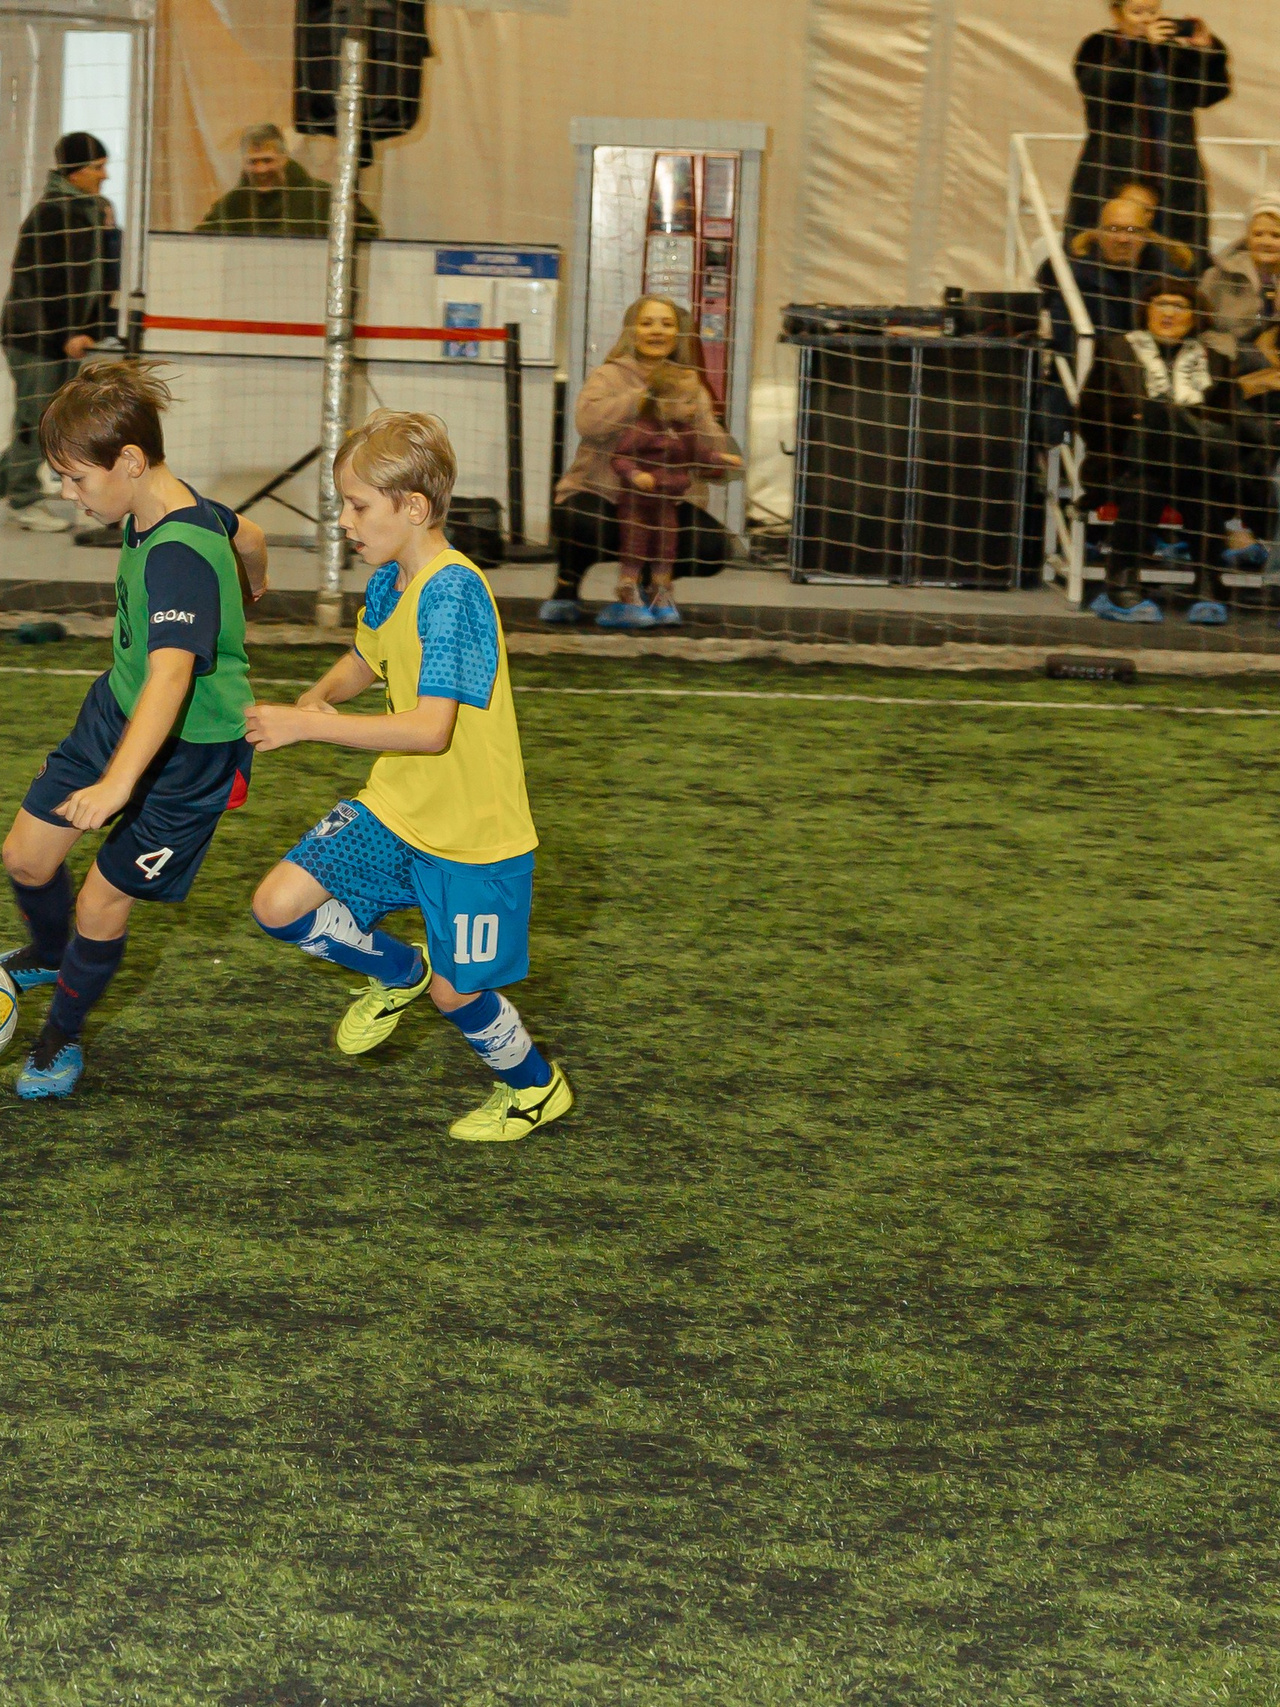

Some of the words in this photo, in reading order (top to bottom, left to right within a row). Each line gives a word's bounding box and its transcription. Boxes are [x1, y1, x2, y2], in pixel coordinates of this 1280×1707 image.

[152, 609, 195, 624] GOAT
[135, 847, 174, 880] 4
[453, 913, 499, 964] 10
